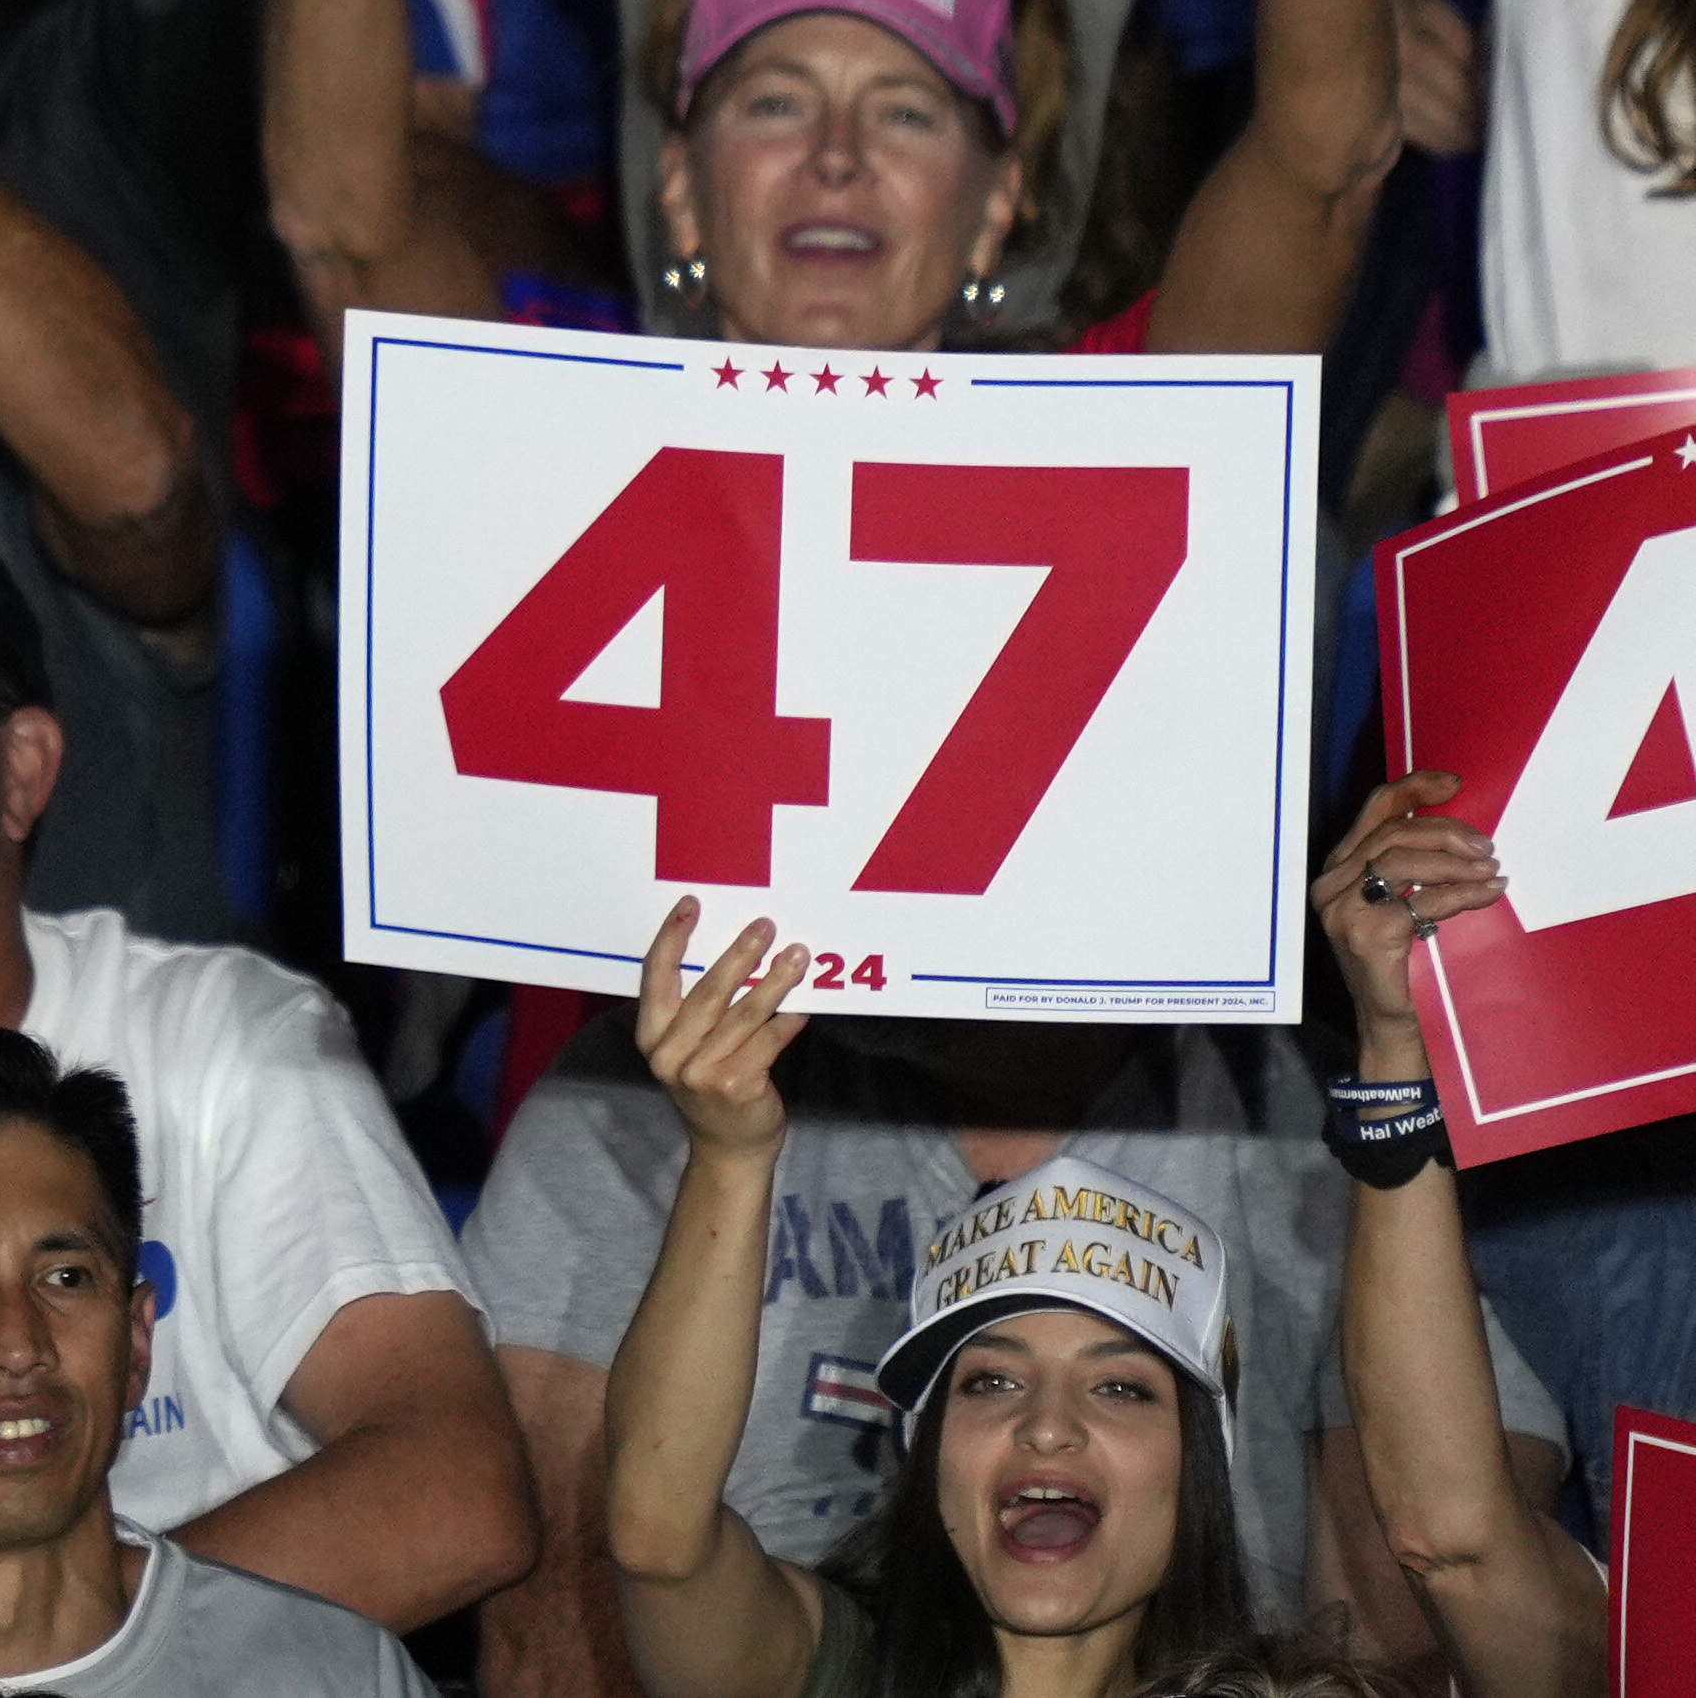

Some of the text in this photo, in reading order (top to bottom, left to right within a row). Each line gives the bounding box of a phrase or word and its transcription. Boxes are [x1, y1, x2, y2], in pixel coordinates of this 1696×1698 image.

[439, 446, 1190, 895] 47
[993, 994, 1017, 1003] PAID
[1019, 994, 1038, 1003] FOR
[1041, 995, 1053, 1004] BY
[1056, 996, 1097, 1005] DONALD
[1109, 997, 1143, 1006] TRUMP
[1145, 997, 1165, 1006] FOR
[1167, 997, 1220, 1007] PRESIDENT
[1249, 998, 1268, 1007] INC.
[1360, 1106, 1446, 1141] Hal Weat
[925, 1185, 1205, 1276] MAKE AMERICA
[935, 1237, 1180, 1313] GREAT AGAIN
